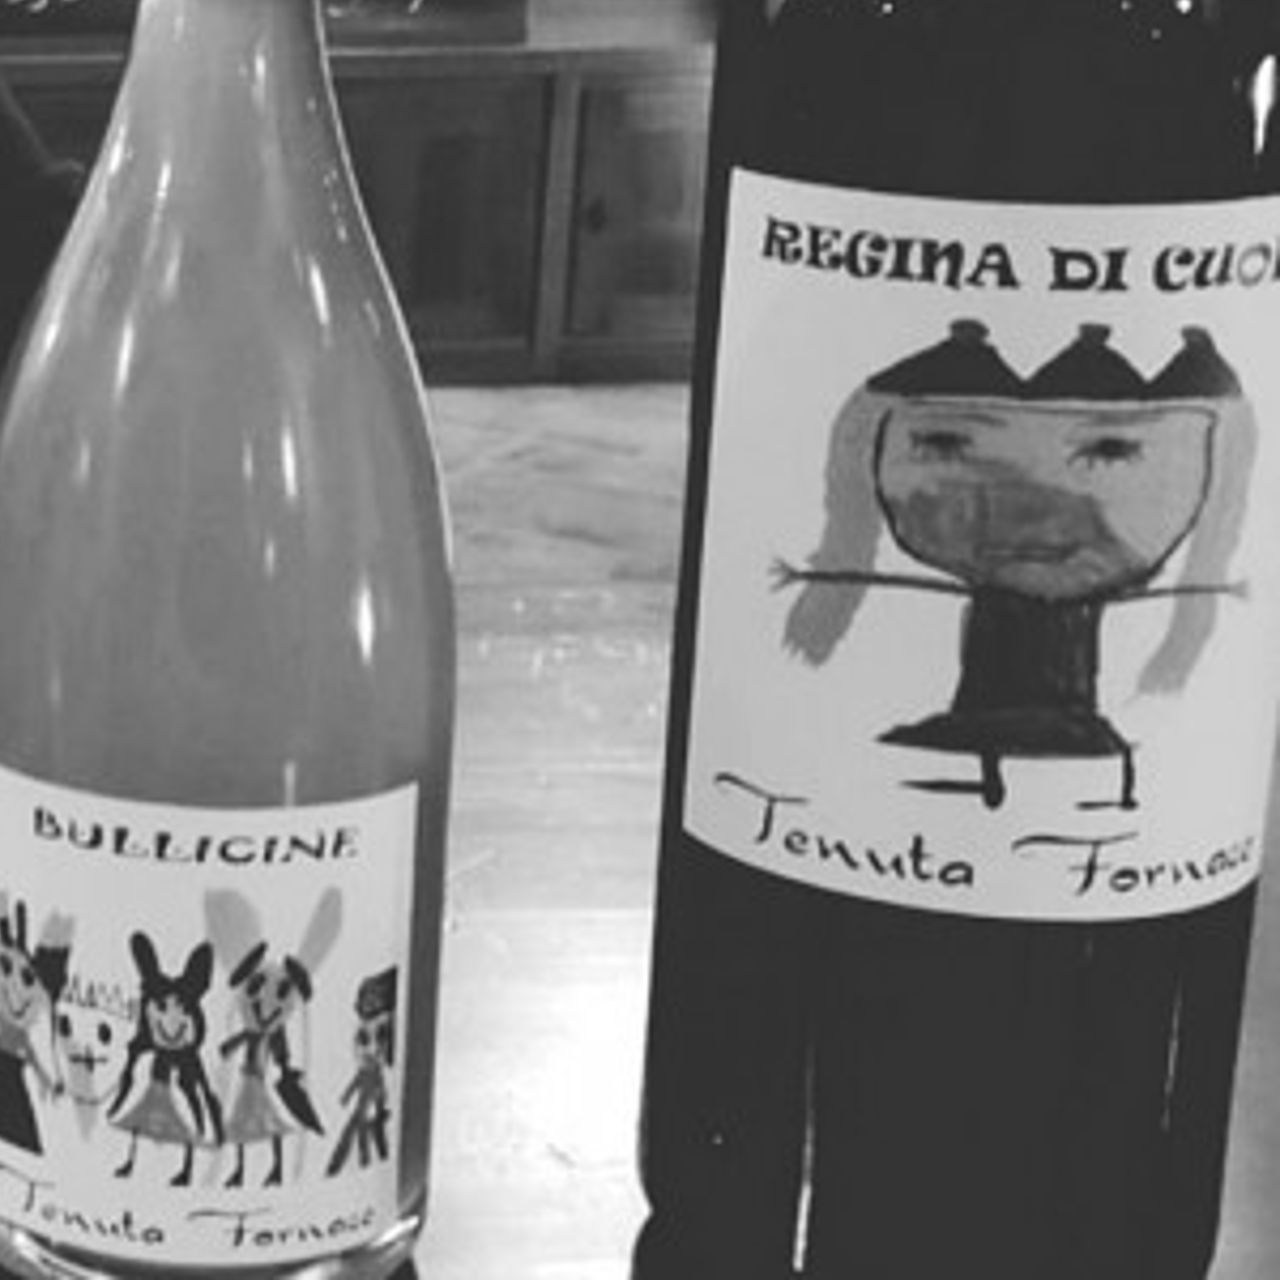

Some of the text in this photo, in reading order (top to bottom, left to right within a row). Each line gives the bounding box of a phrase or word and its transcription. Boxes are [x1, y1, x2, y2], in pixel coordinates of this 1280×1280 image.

[761, 216, 1280, 294] REGINA DI CUO
[33, 806, 360, 866] BULLICINE
[713, 772, 975, 888] Tenuta
